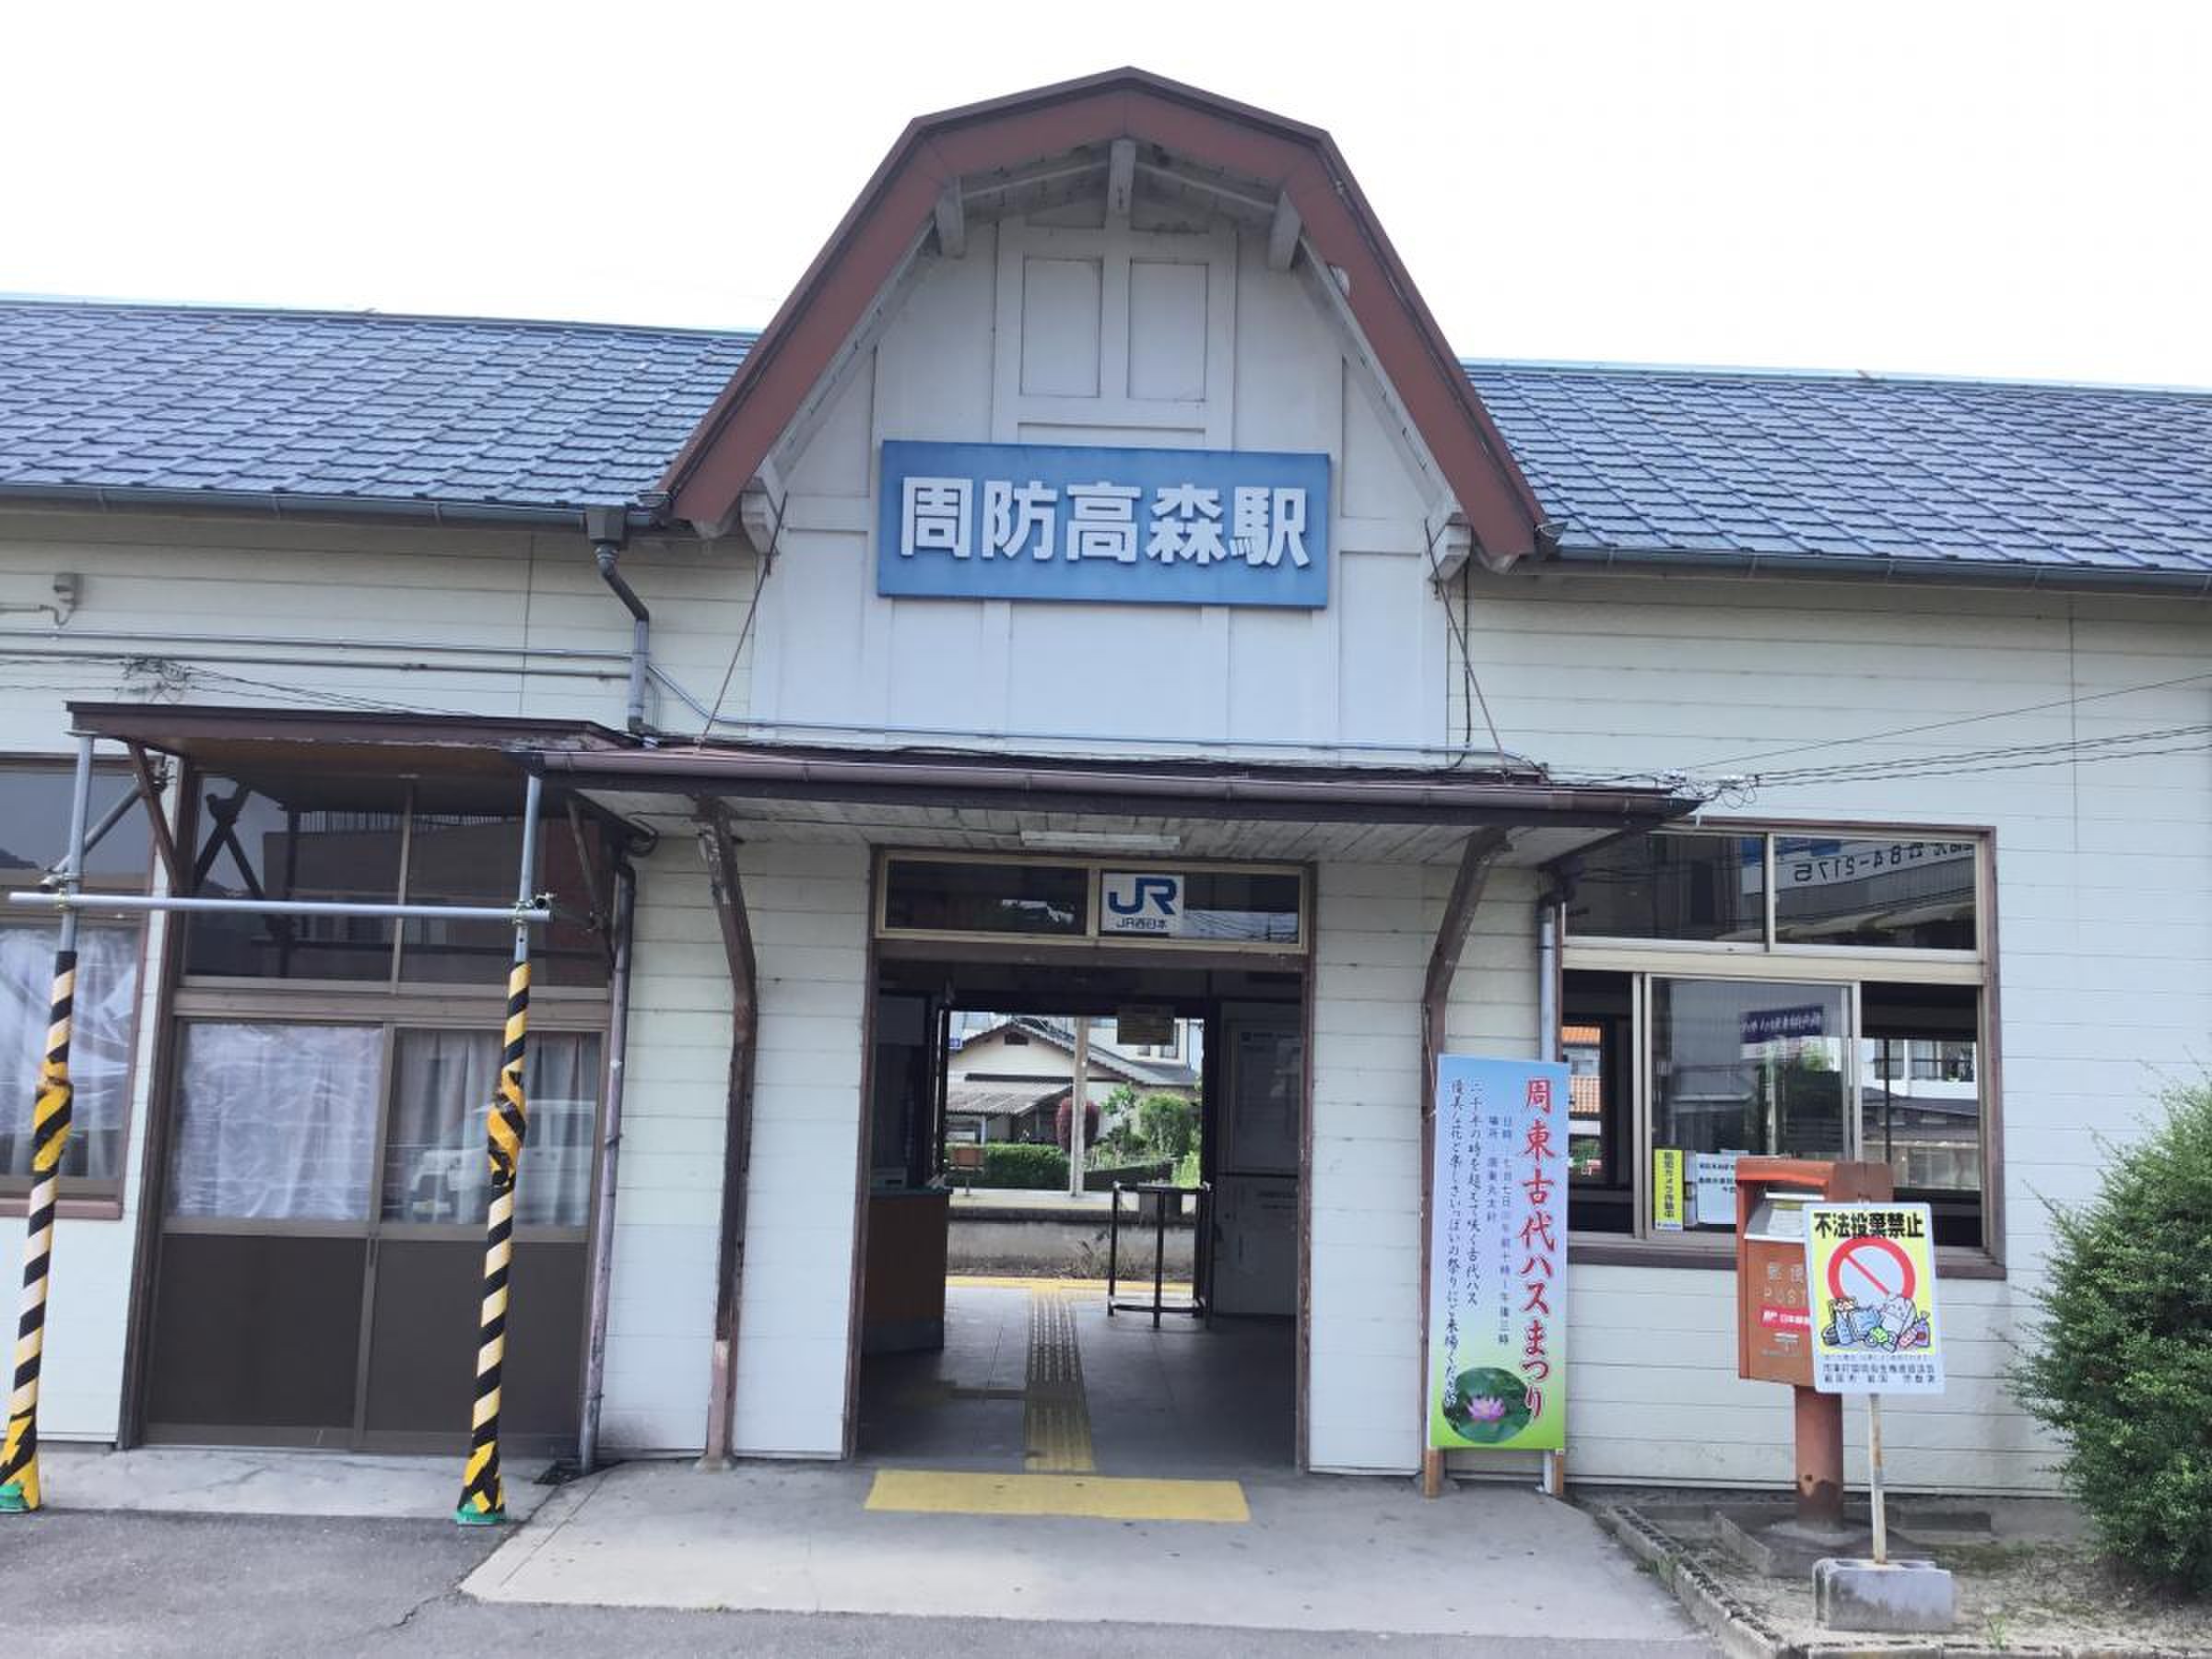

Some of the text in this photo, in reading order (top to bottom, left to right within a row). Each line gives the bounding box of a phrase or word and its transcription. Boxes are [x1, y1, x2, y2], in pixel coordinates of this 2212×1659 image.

[900, 477, 1312, 567] 周防高森駅
[1108, 877, 1177, 915] JR
[1116, 917, 1168, 929] JR西日本
[1813, 1211, 1925, 1240] 不法投棄禁止
[1520, 1077, 1555, 1418] 周東古代ハスまつり
